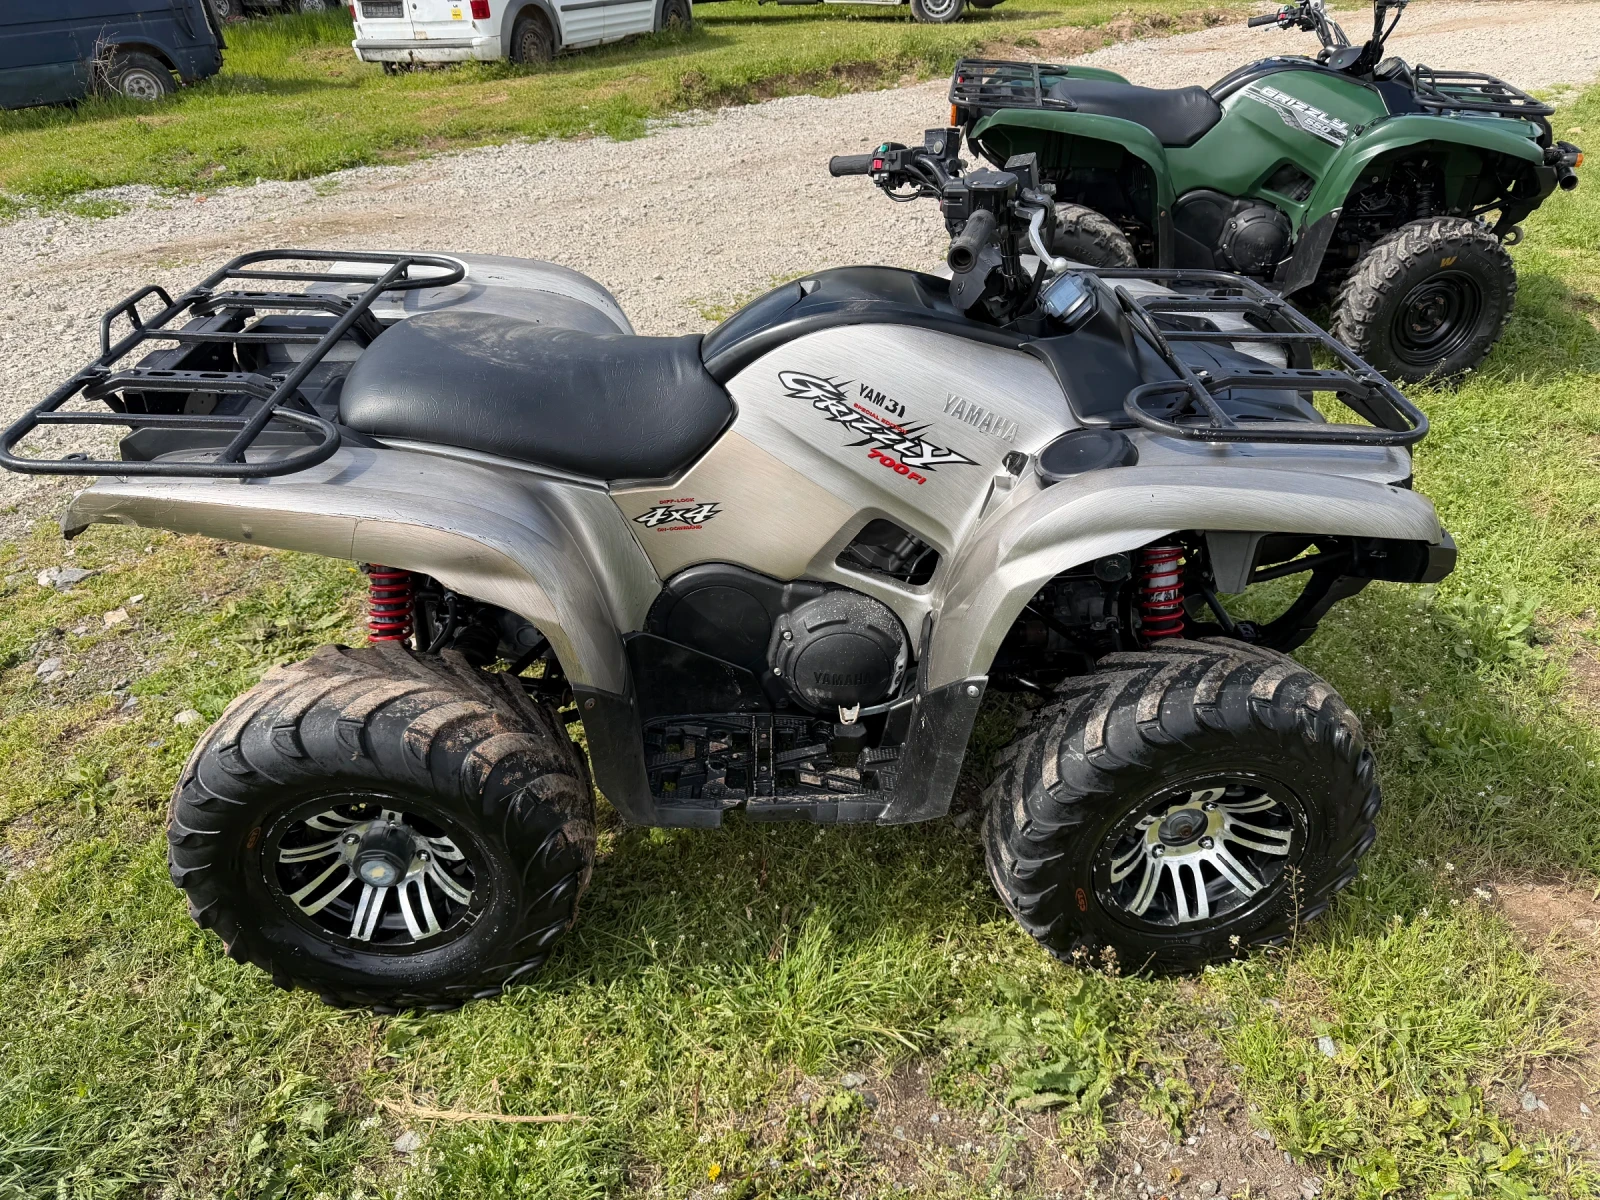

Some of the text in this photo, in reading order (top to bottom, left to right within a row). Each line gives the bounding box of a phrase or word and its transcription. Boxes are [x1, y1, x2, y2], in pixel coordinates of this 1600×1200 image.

[1260, 85, 1350, 131] GRIZZLY
[853, 402, 880, 421] SPECIAL
[941, 391, 1020, 444] YAMAHA
[813, 671, 873, 687] YAMAHA
